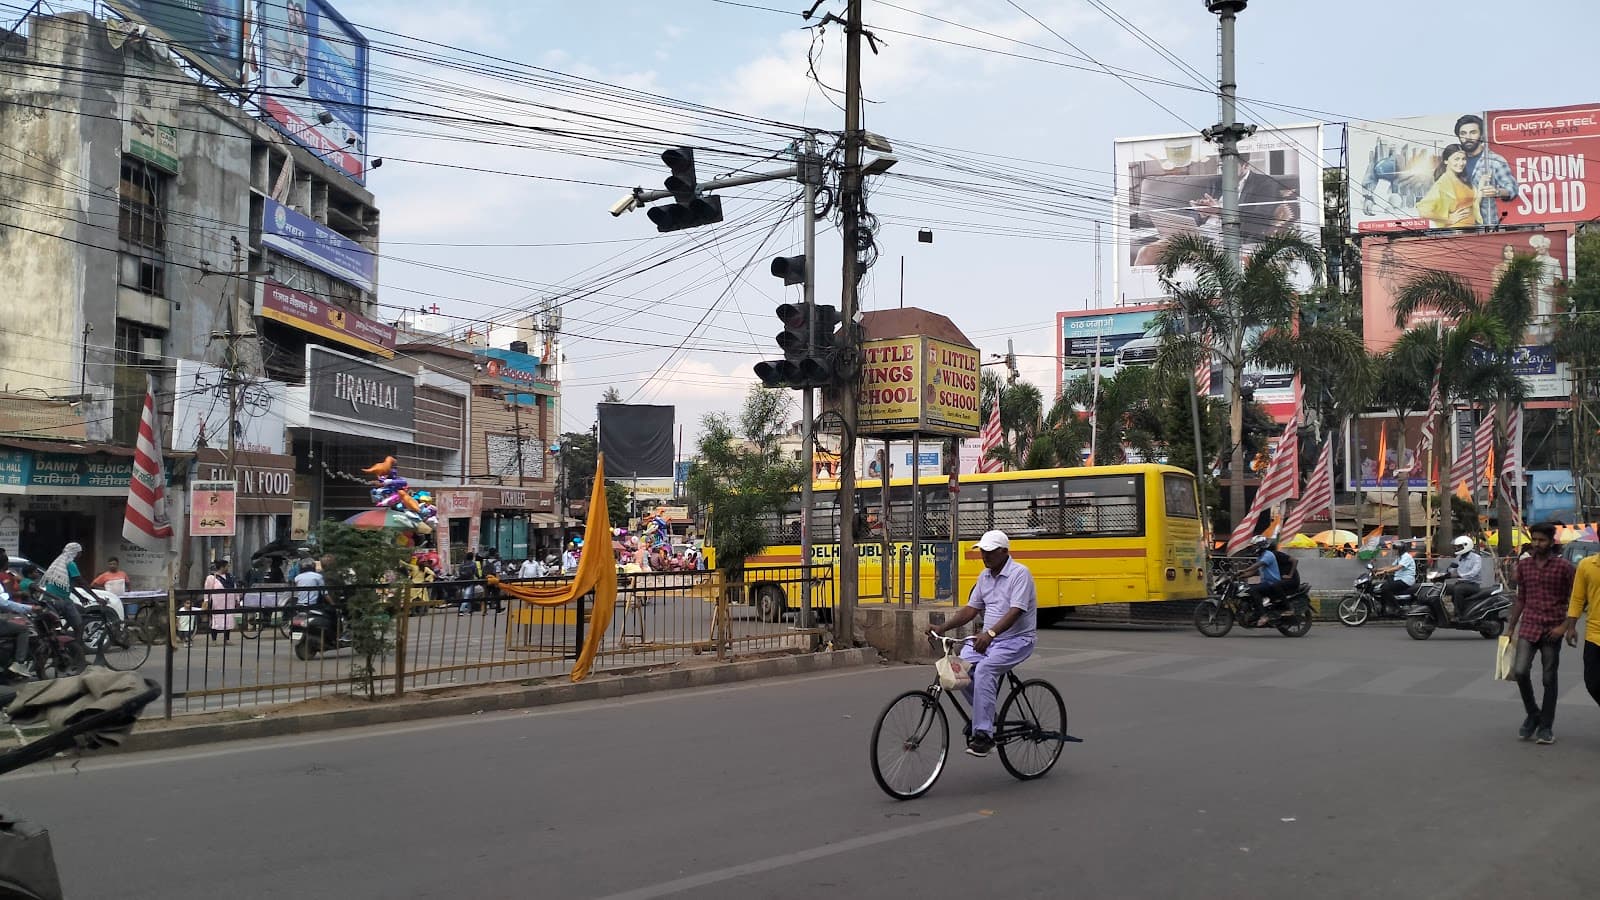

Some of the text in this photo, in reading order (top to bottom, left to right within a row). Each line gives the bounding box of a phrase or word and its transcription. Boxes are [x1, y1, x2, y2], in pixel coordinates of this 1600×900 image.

[1501, 117, 1597, 131] RUNGTA STEEL
[1520, 127, 1578, 137] TMT BAR
[1516, 154, 1585, 183] EKDUM
[1517, 181, 1586, 216] SOLID
[861, 345, 914, 364] ITTLE
[942, 349, 976, 372] LITTLE
[943, 369, 976, 392] WINGS
[335, 372, 399, 414] FIRAYALAL
[860, 387, 917, 406] CHOOL
[940, 390, 978, 412] SCHOOL
[36, 461, 133, 474] DAMIN MEDICA
[33, 475, 80, 485] दामिनी
[244, 470, 253, 493] N
[258, 471, 290, 494] FOOD
